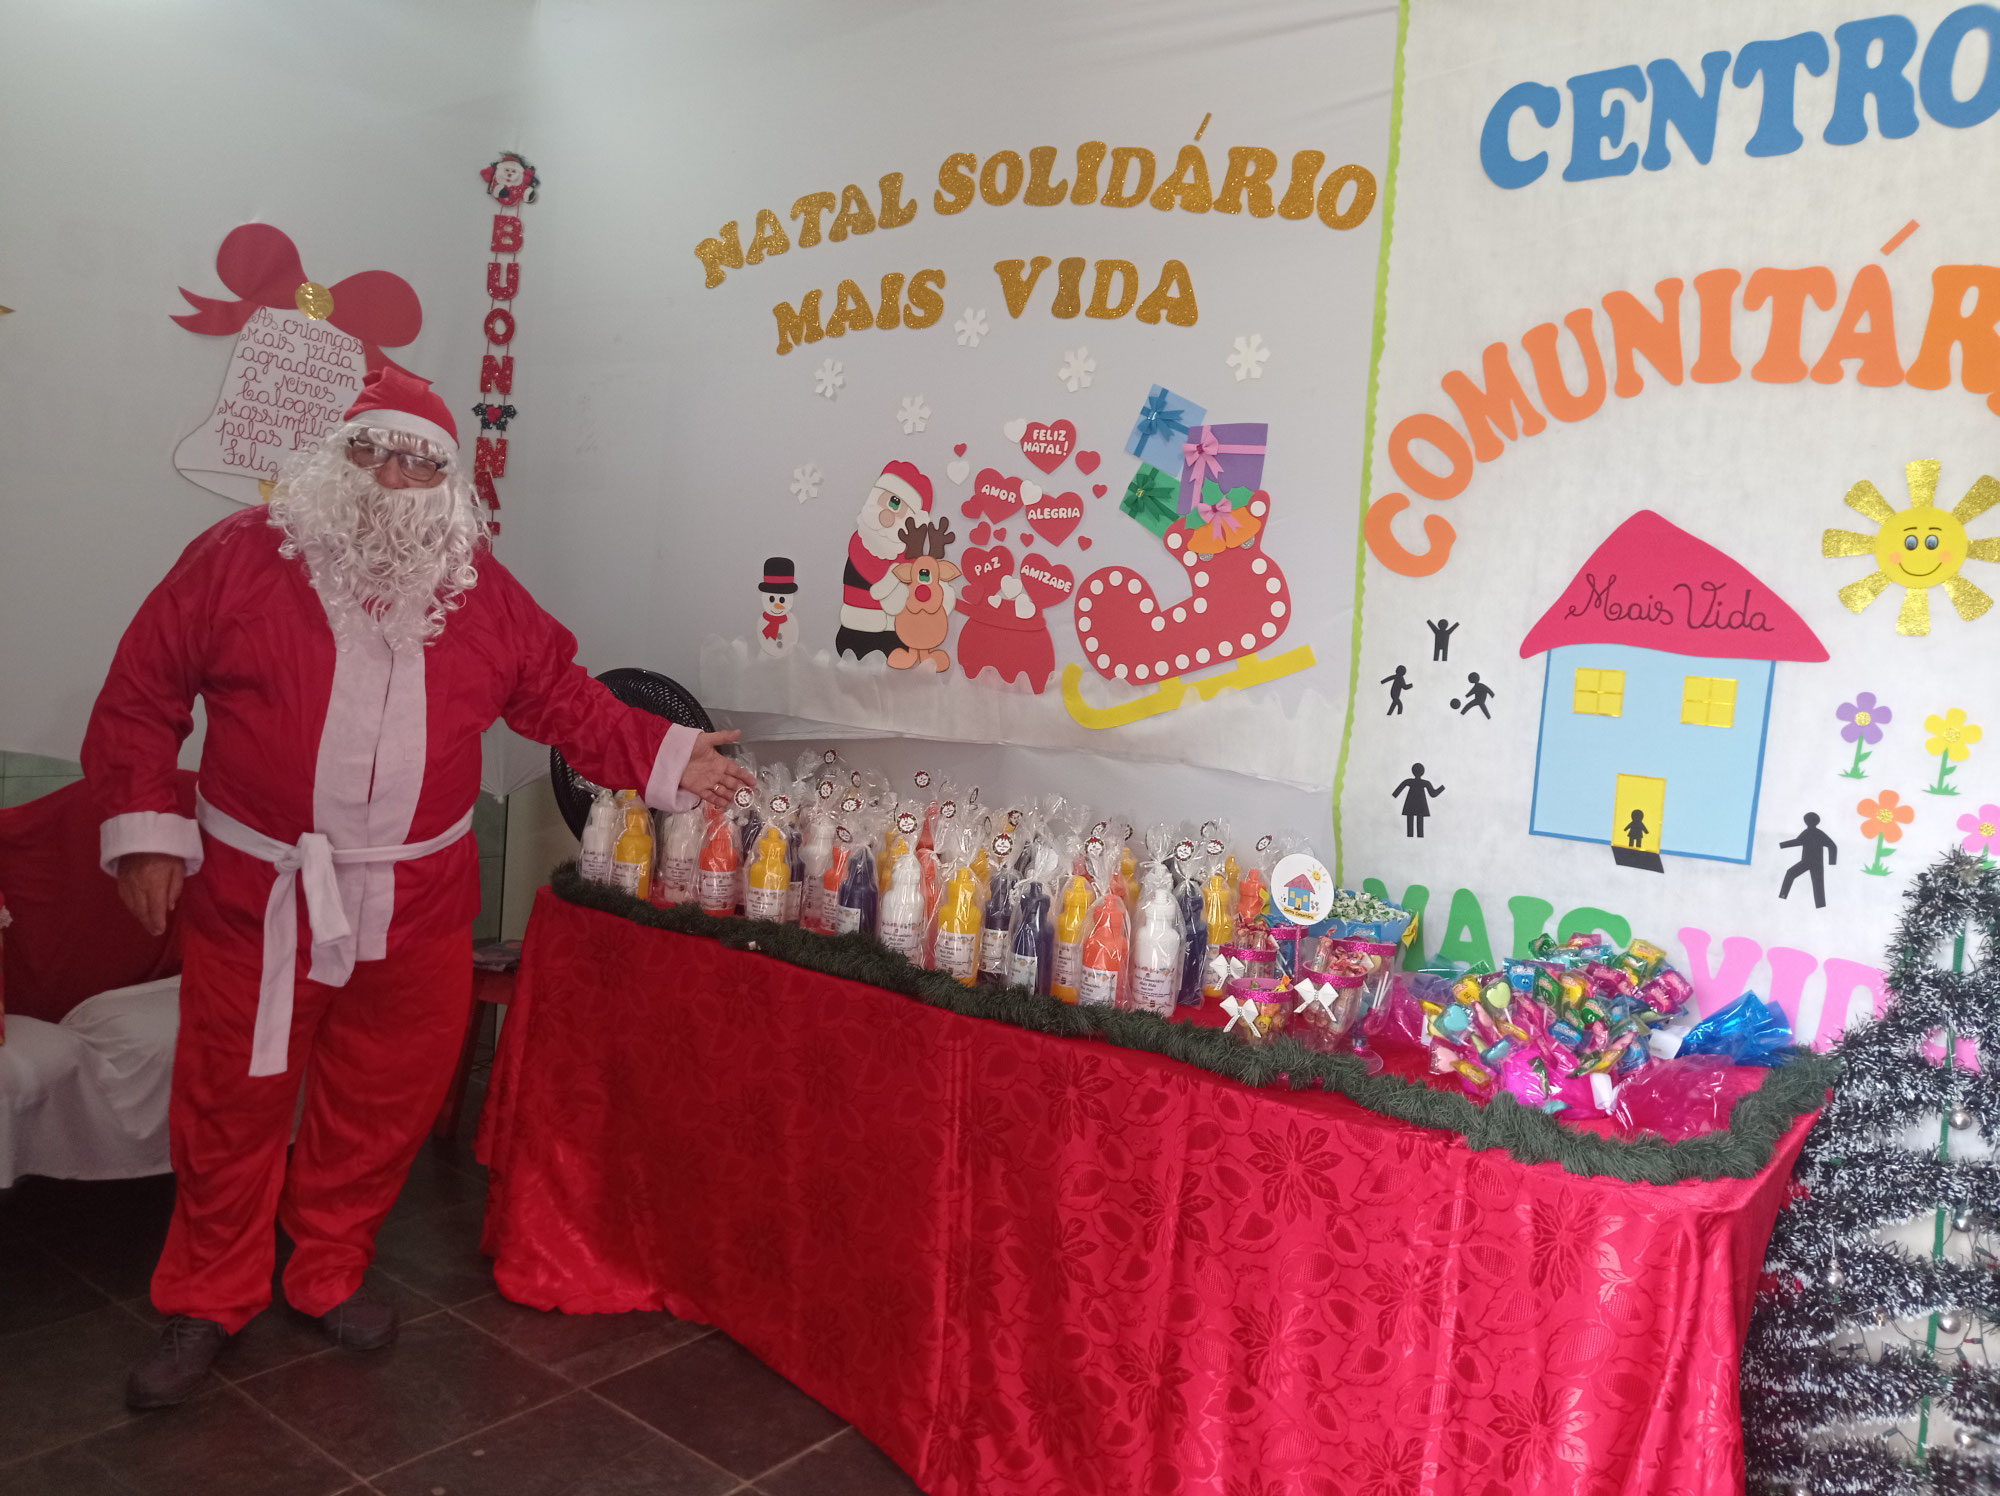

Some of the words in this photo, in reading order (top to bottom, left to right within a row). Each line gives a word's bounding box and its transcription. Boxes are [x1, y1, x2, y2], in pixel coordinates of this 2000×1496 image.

[1480, 4, 2000, 189] CENTRO
[695, 172, 917, 288] NATAL
[933, 112, 1377, 231] SOLIDÁRIO
[480, 214, 524, 395] BUON
[773, 269, 946, 355] MAIS
[994, 255, 1199, 327] VIDA
[240, 327, 295, 353] Mais
[252, 306, 278, 330] As
[281, 320, 364, 355] crianças
[237, 347, 358, 391] agradecem
[238, 366, 262, 384] a
[1363, 220, 2000, 578] COMUNITÁR
[215, 419, 282, 447] pelas
[1023, 441, 1069, 456] NATAL!
[1033, 429, 1067, 442] FELIZ
[223, 439, 280, 480] Feliz
[981, 484, 1017, 504] AMOR
[1027, 507, 1081, 520] ALEGRIA
[974, 556, 1001, 576] PAZ
[1020, 564, 1072, 593] AMIZADE
[1564, 573, 1673, 626] Mais
[1673, 581, 1775, 632] Vida
